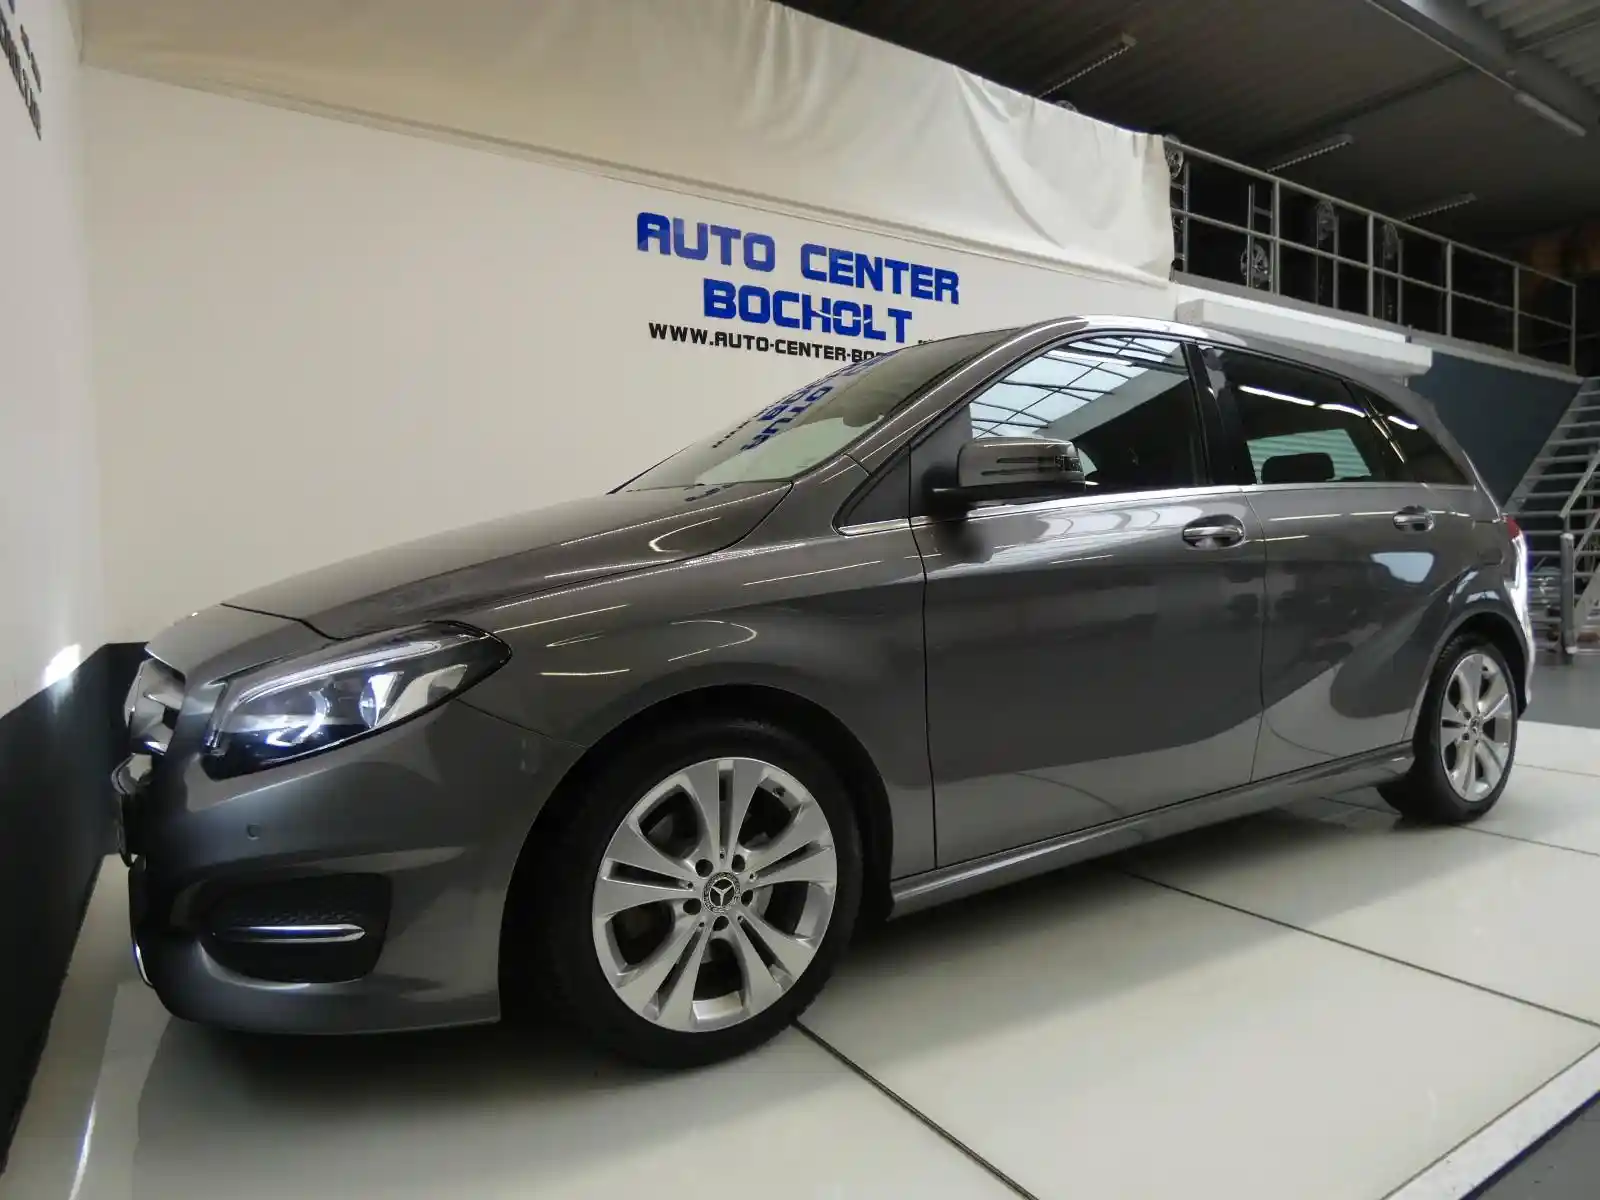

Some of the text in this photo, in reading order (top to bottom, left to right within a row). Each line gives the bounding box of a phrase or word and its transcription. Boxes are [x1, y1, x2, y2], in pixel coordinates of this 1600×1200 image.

[637, 212, 960, 305] AUTO CENTER
[703, 278, 912, 343] BOCHOLT
